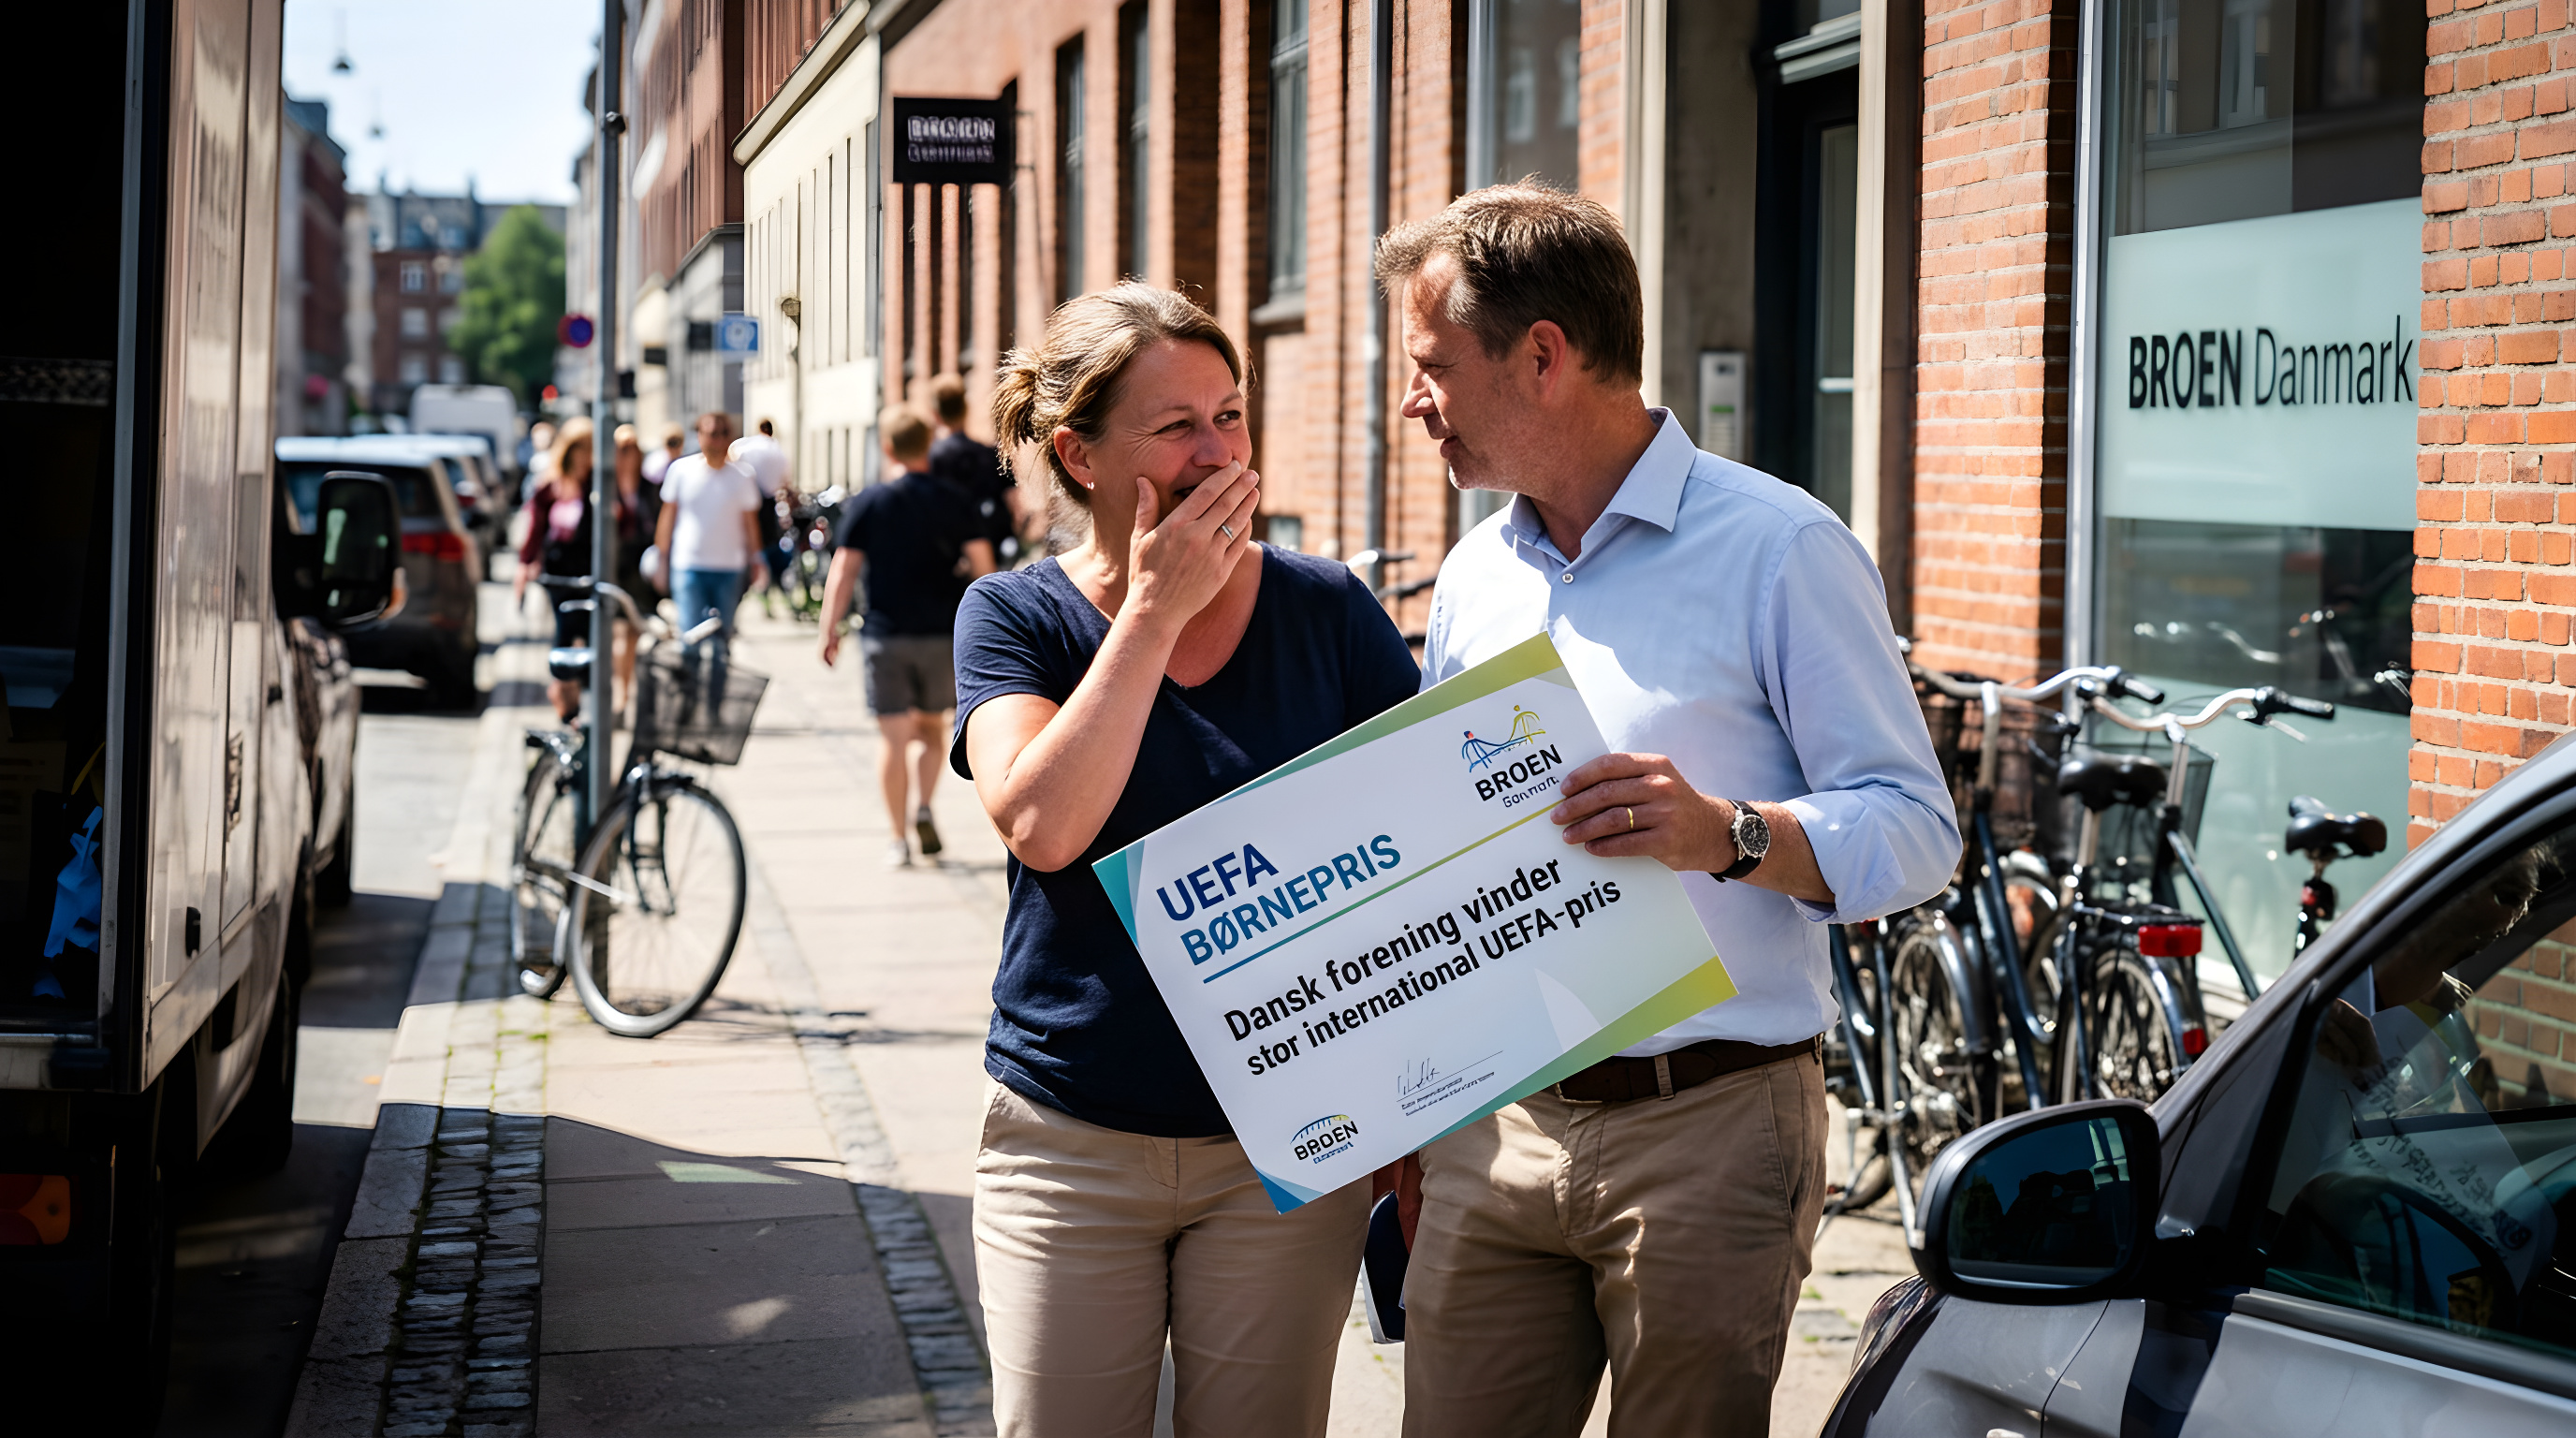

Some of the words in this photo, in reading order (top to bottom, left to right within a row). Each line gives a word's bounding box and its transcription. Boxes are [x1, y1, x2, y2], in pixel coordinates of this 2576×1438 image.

[2129, 330, 2244, 409] BROEN
[2255, 315, 2414, 406] Danmark
[1475, 744, 1562, 801] BROEN
[1156, 843, 1280, 921] UEFA
[1179, 834, 1401, 966] BØRNEPRIS
[1224, 975, 1326, 1042] Dansk
[1325, 911, 1462, 992] forening
[1461, 858, 1561, 924] vinder
[1247, 1034, 1300, 1076] stor
[1302, 943, 1481, 1049] international
[1479, 880, 1621, 961] UEFA-pris
